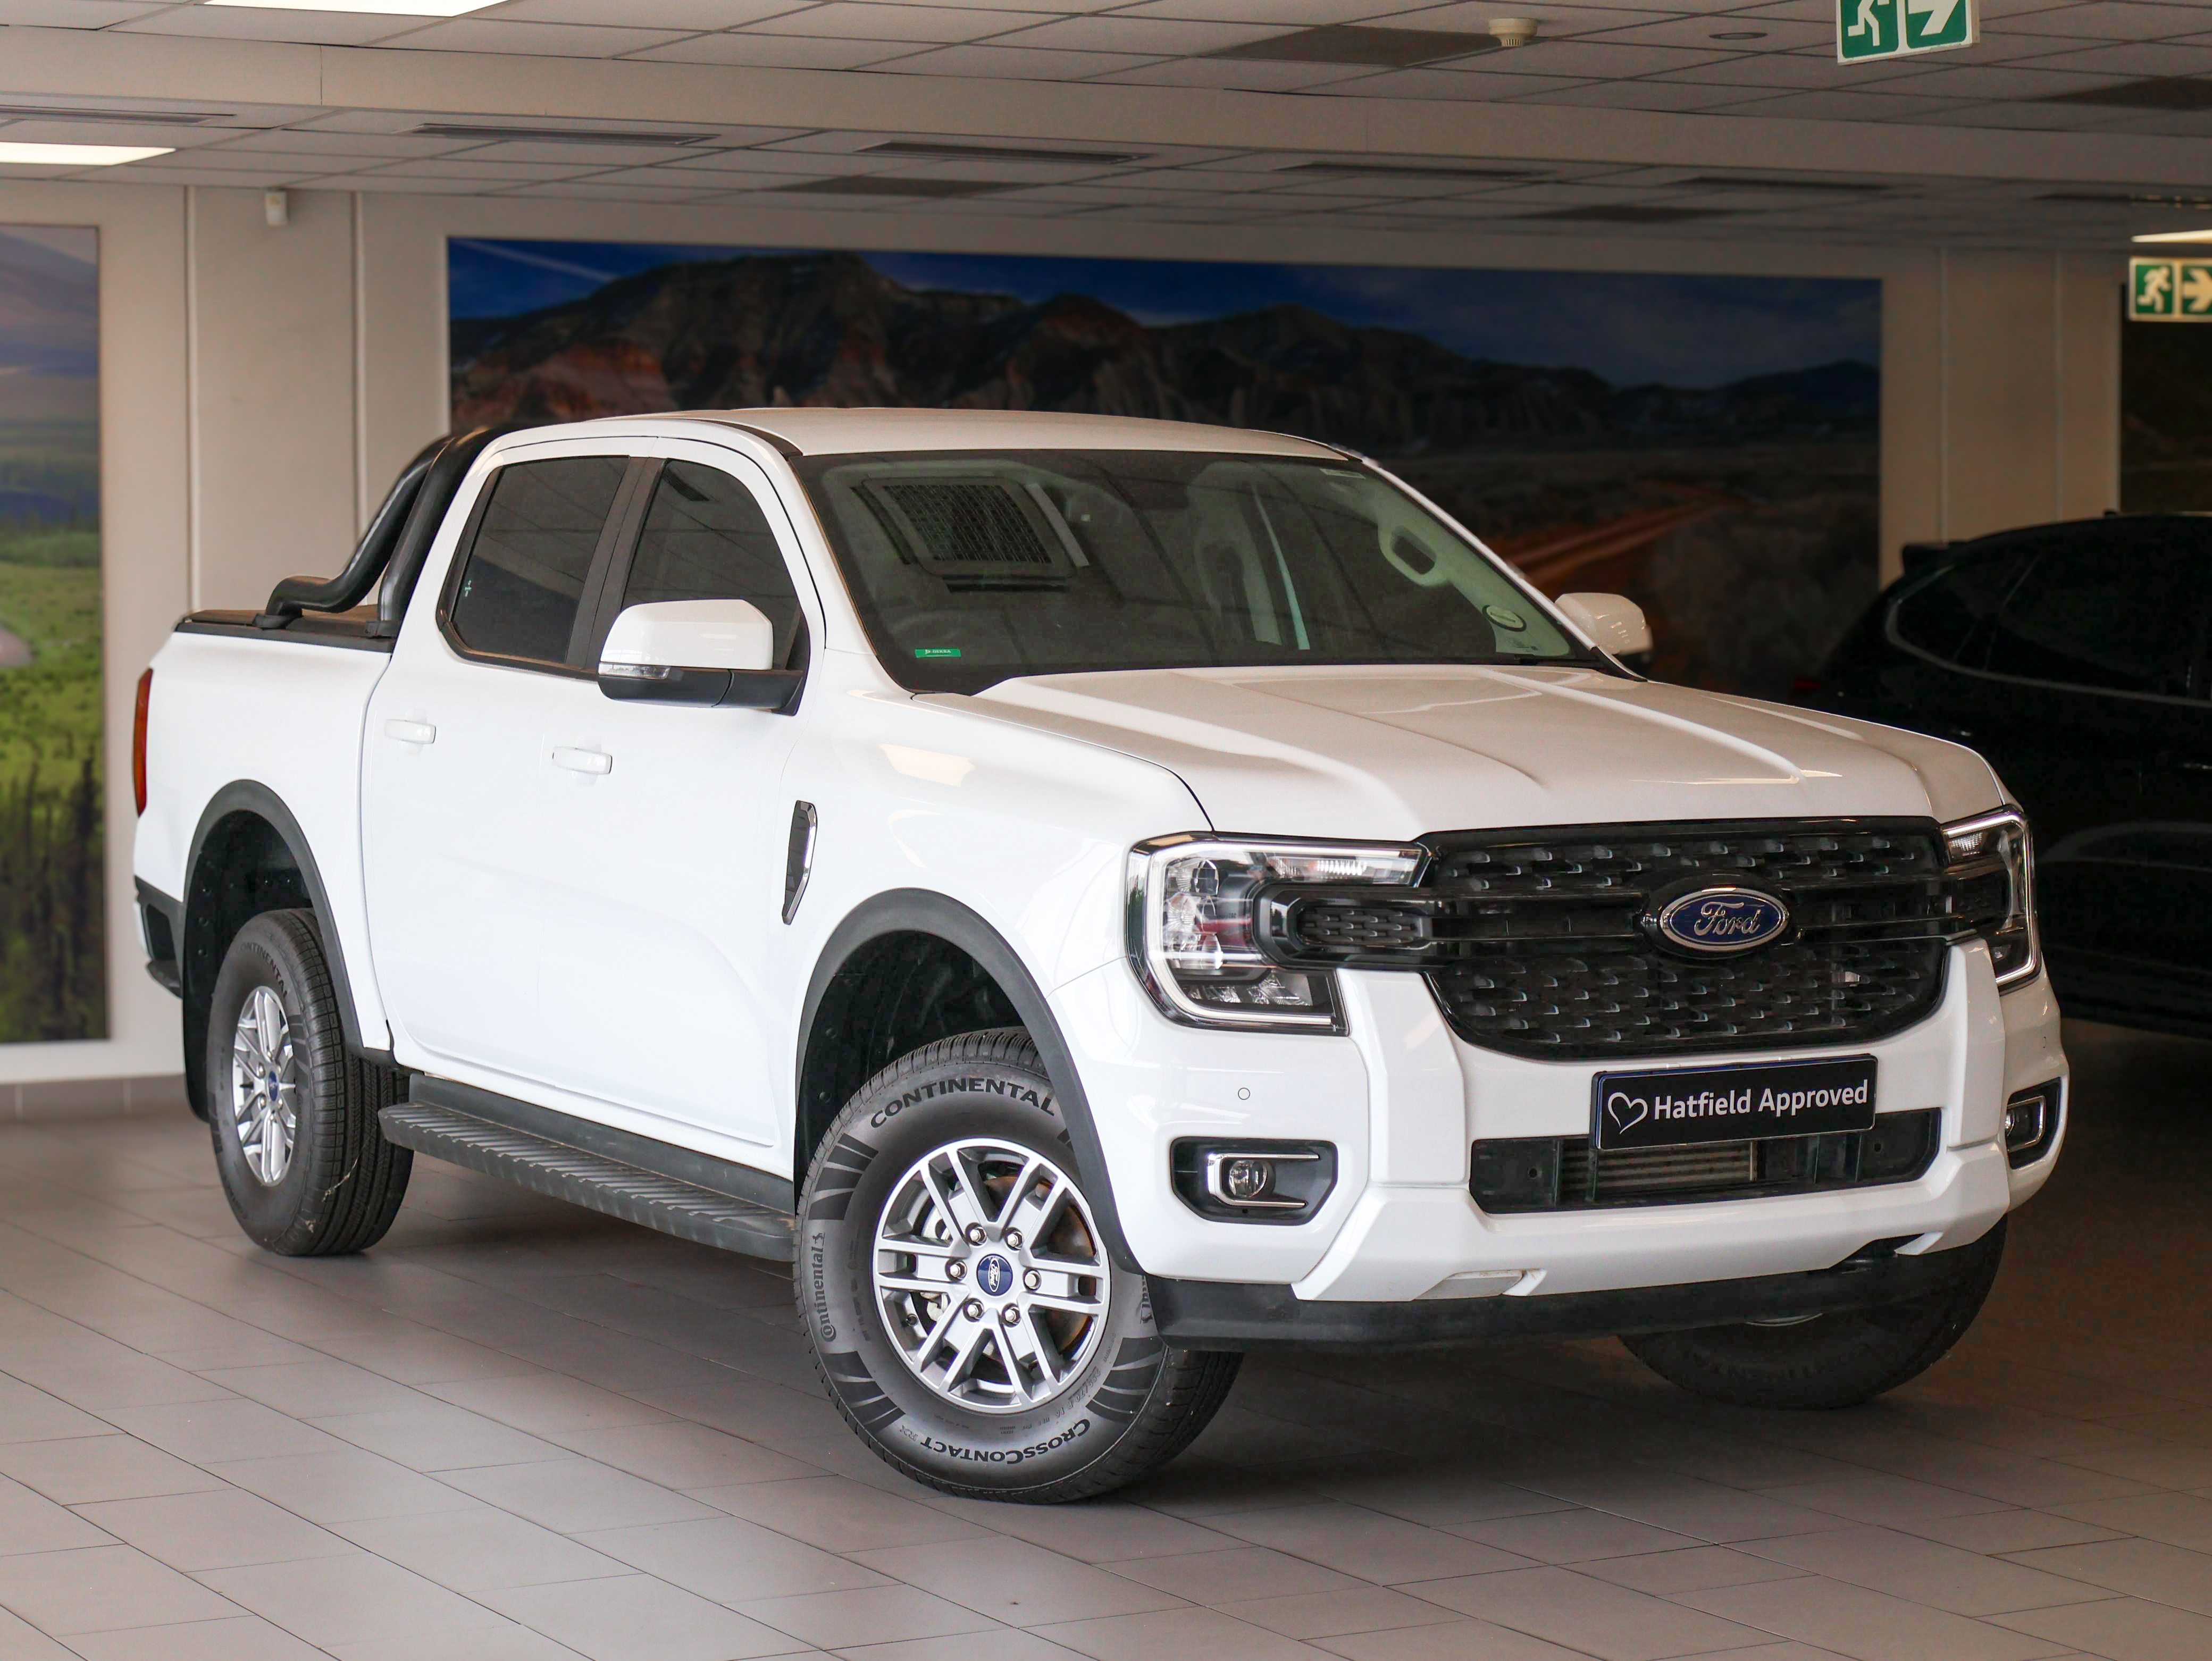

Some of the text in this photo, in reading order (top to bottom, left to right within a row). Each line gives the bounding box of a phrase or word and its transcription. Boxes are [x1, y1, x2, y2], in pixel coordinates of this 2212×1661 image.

[1694, 901, 1762, 936] Ford
[237, 941, 288, 1005] ONTINENTAL
[870, 1078, 1055, 1128] CONTINENTAL
[1654, 1079, 1868, 1120] Hatfield Approved
[811, 1246, 837, 1343] Continental
